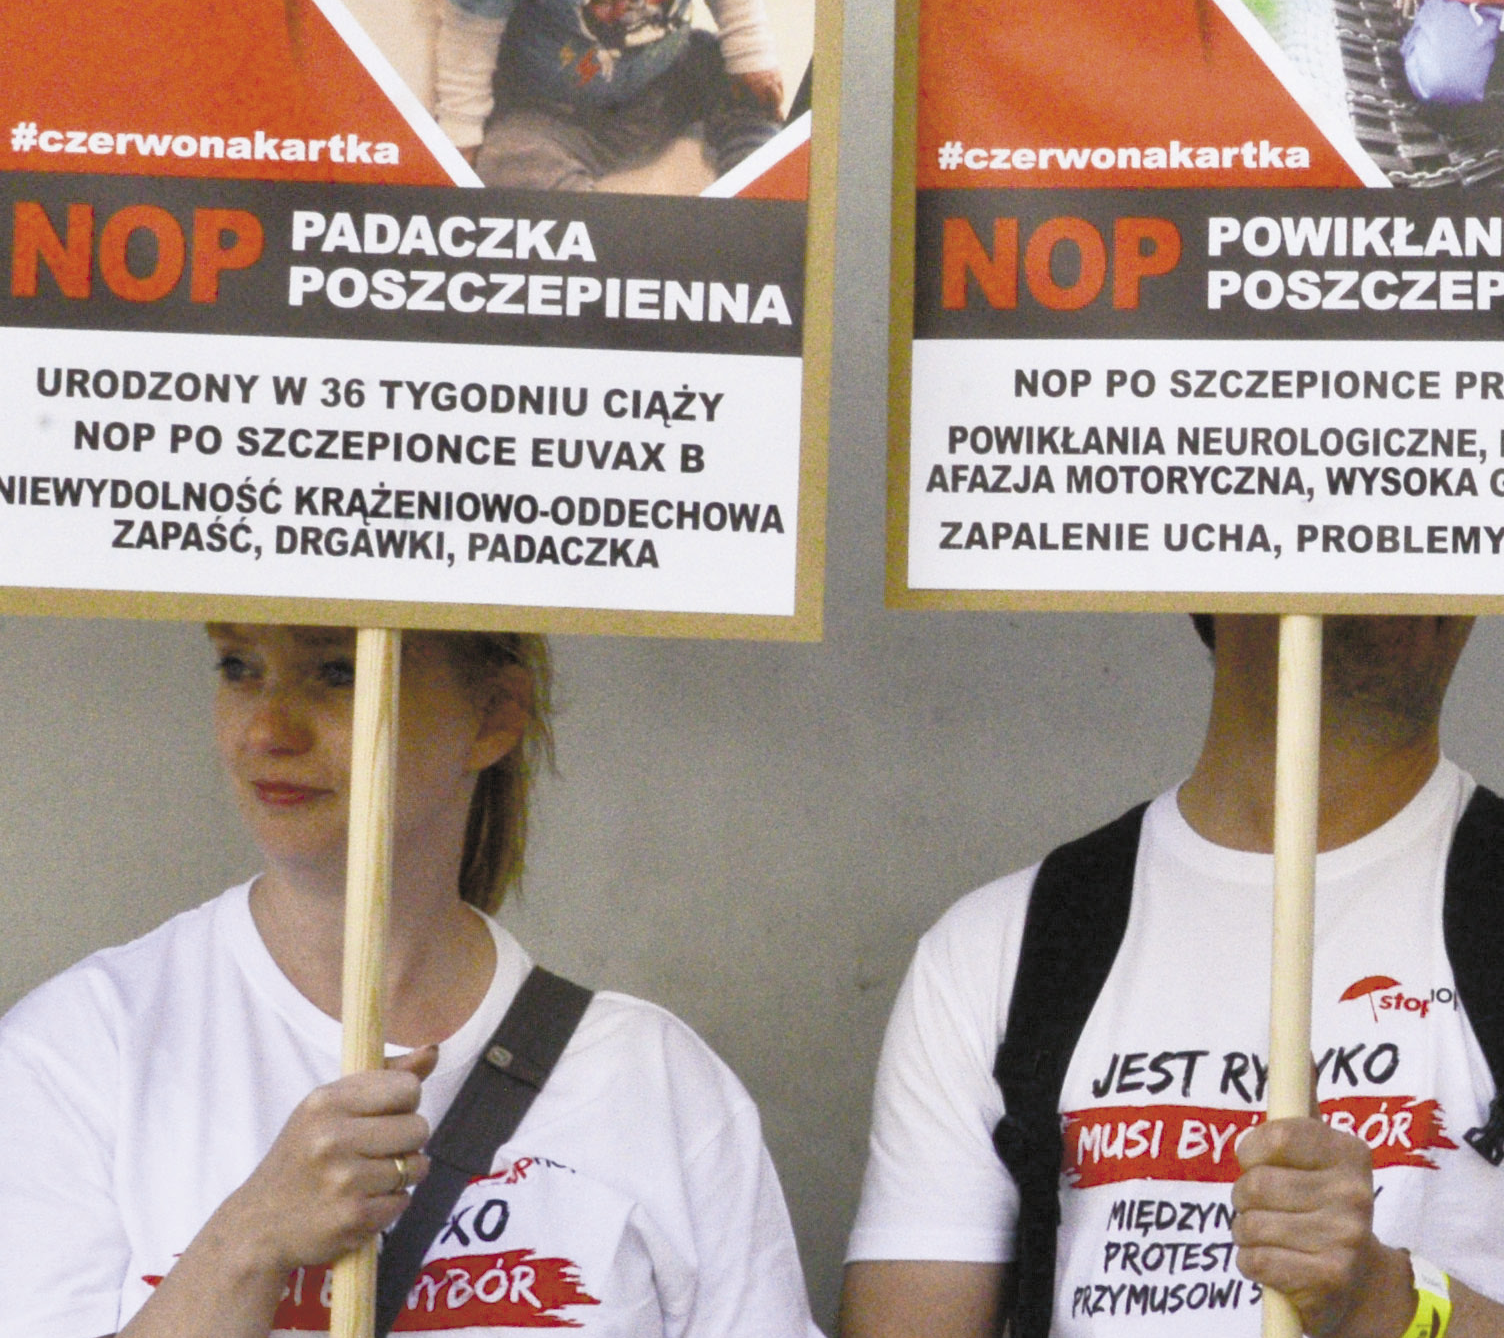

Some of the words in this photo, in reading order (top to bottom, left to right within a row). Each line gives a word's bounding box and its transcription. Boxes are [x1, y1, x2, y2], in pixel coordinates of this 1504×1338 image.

[11, 121, 400, 165] #czerwonakartka
[938, 140, 1311, 173] #czerwonakartka
[11, 200, 264, 304] NOP
[292, 210, 596, 262] PADACZKA
[940, 217, 1181, 311] NOP
[288, 266, 793, 326] POSZCZEPIENNA
[37, 366, 260, 407] URODZONY
[275, 377, 308, 407] W
[320, 377, 366, 409] 36
[380, 379, 590, 416] TYGODNIU
[603, 385, 725, 428] CIĄŻY
[1014, 369, 1093, 399] NOP
[1106, 368, 1157, 399] PO
[1170, 368, 1442, 400] SZCZEPIONCE
[73, 420, 156, 454] NOP
[170, 424, 222, 456] PO
[236, 427, 517, 468] SZCZEPIONCE
[531, 437, 668, 472] EUVAX
[679, 442, 706, 473] B
[948, 426, 1164, 456] POWIKŁANIA
[1177, 426, 1487, 463] NEUROLOGICZNE,
[926, 464, 1054, 495] AFAZJA
[1065, 465, 1315, 503] MOTORYCZNA,
[1326, 467, 1479, 497] WYSOKA
[295, 486, 786, 535] KRĄŻENIOWO-ODDECHOWA
[111, 517, 263, 560] ZAPAŚĆ,
[275, 529, 456, 568] DRGAWKI,
[467, 532, 660, 569] PADACZKA
[939, 522, 1150, 551] ZAPALENIE
[1163, 523, 1284, 560] UCHA,
[1092, 1049, 1210, 1099] JEST
[1076, 1120, 1163, 1165] MUSI
[1072, 1283, 1250, 1319] PRZYMUSOWI
